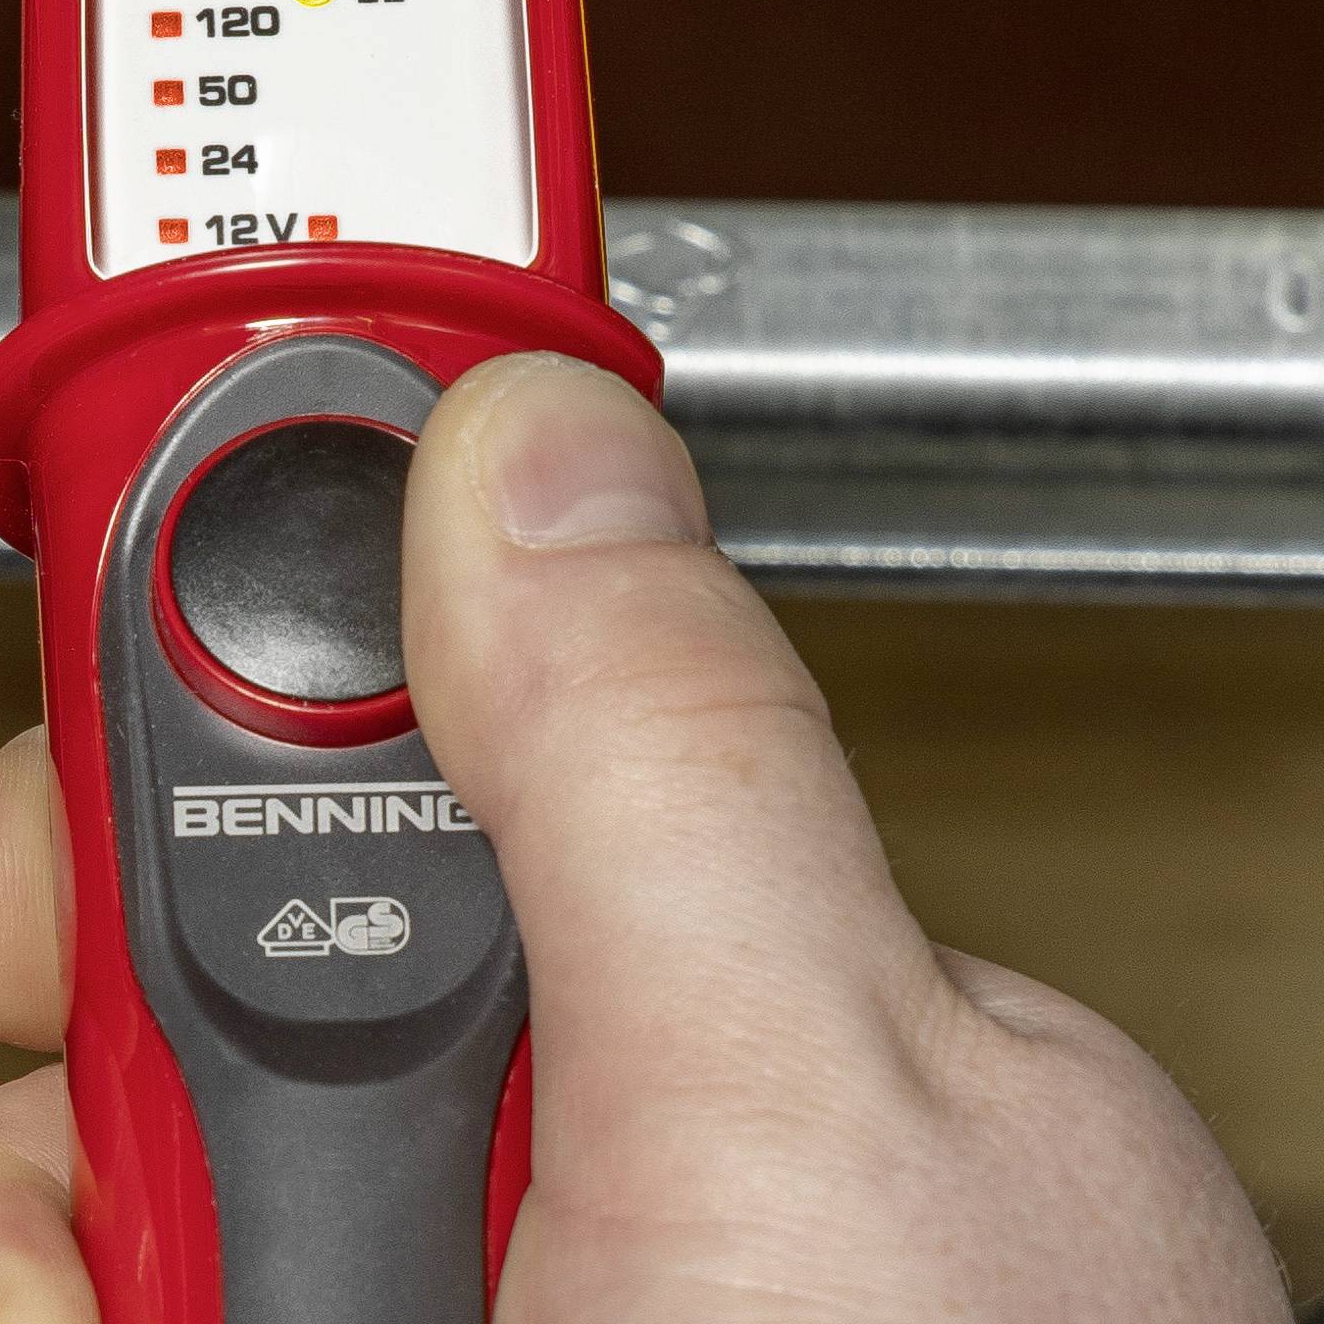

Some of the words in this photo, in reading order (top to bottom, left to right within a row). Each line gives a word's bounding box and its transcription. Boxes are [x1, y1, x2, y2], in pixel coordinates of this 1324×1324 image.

[195, 5, 280, 38] 120
[198, 74, 258, 107] 50
[201, 144, 259, 176] 24
